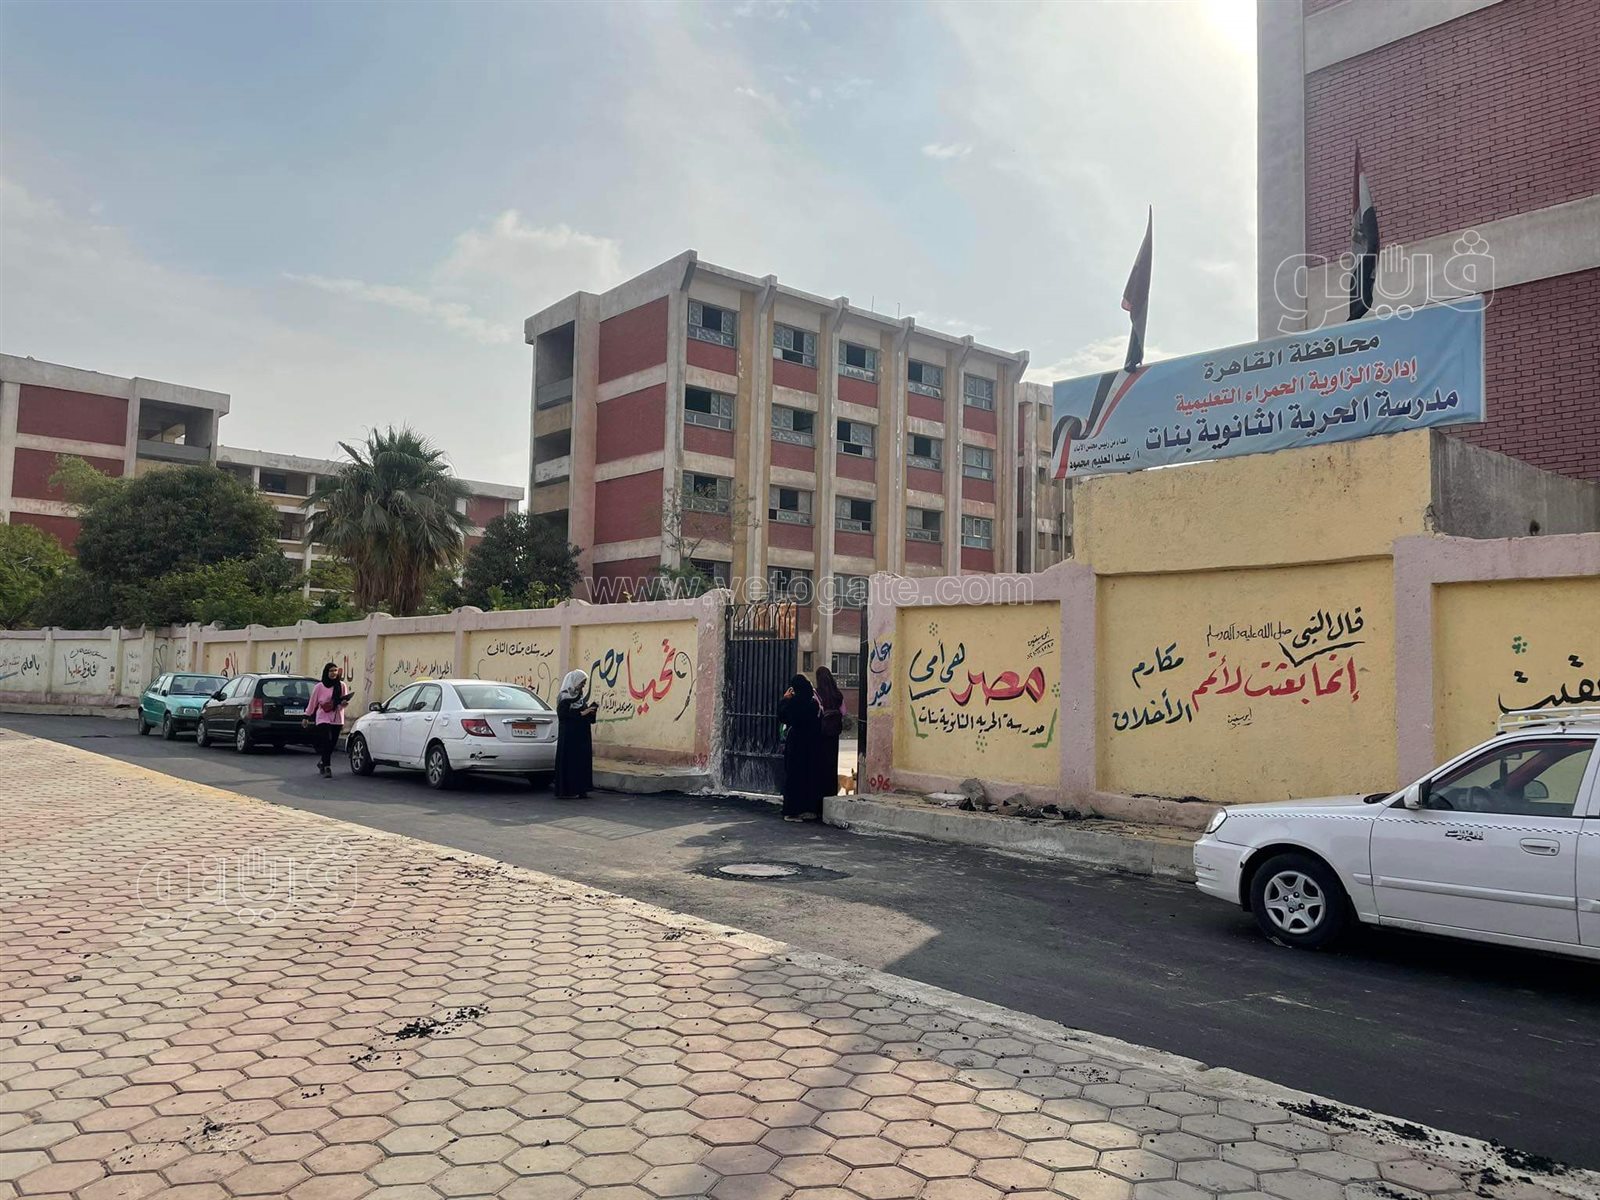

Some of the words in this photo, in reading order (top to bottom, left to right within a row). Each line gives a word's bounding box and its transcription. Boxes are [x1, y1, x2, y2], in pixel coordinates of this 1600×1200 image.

[1290, 333, 1380, 363] محافظة
[1204, 351, 1282, 382] القاهرة
[1310, 366, 1370, 396] الزاوية
[1374, 357, 1417, 383] إدارة
[1175, 390, 1241, 416] التعليمية
[1245, 378, 1303, 405] الحمراء
[1376, 388, 1459, 420] مدرسة
[1198, 410, 1283, 449] الثانوية
[1290, 400, 1369, 438] الحرية
[1145, 426, 1191, 453] بنات
[1115, 452, 1131, 464] عبد
[1328, 606, 1365, 641] قال
[584, 649, 624, 701] مصر
[1132, 642, 1184, 688] مكارم
[949, 666, 1046, 706] مصر
[919, 706, 939, 730] بنات
[940, 708, 973, 733] الثانوية
[1003, 713, 1045, 735] مدرسة
[1112, 688, 1193, 731] الأخلاق
